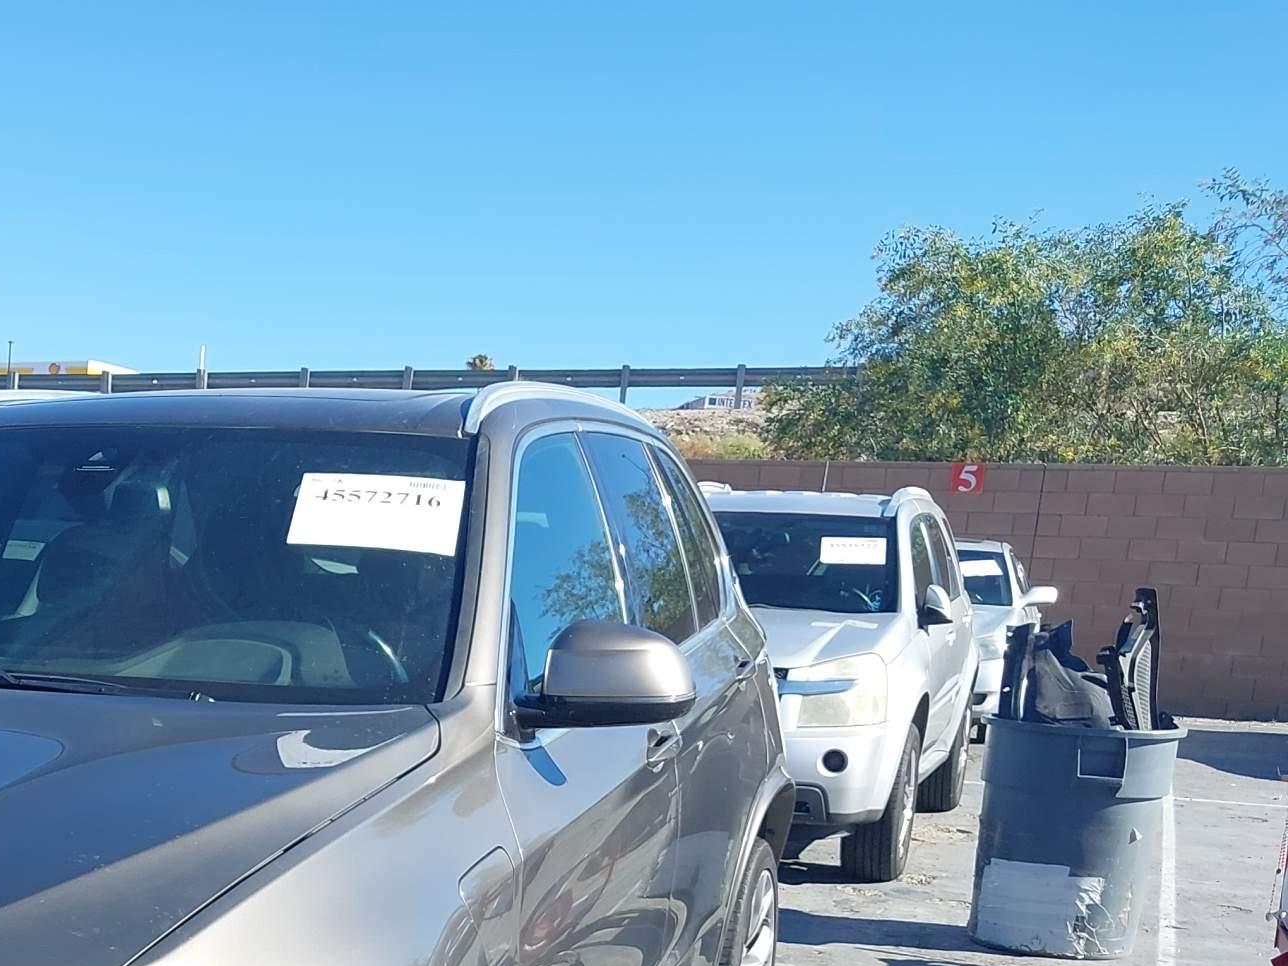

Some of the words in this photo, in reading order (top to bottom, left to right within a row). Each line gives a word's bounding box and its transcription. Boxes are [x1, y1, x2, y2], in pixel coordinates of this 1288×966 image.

[718, 398, 753, 409] INTEEX
[957, 465, 979, 492] 5
[315, 487, 441, 508] 45572716
